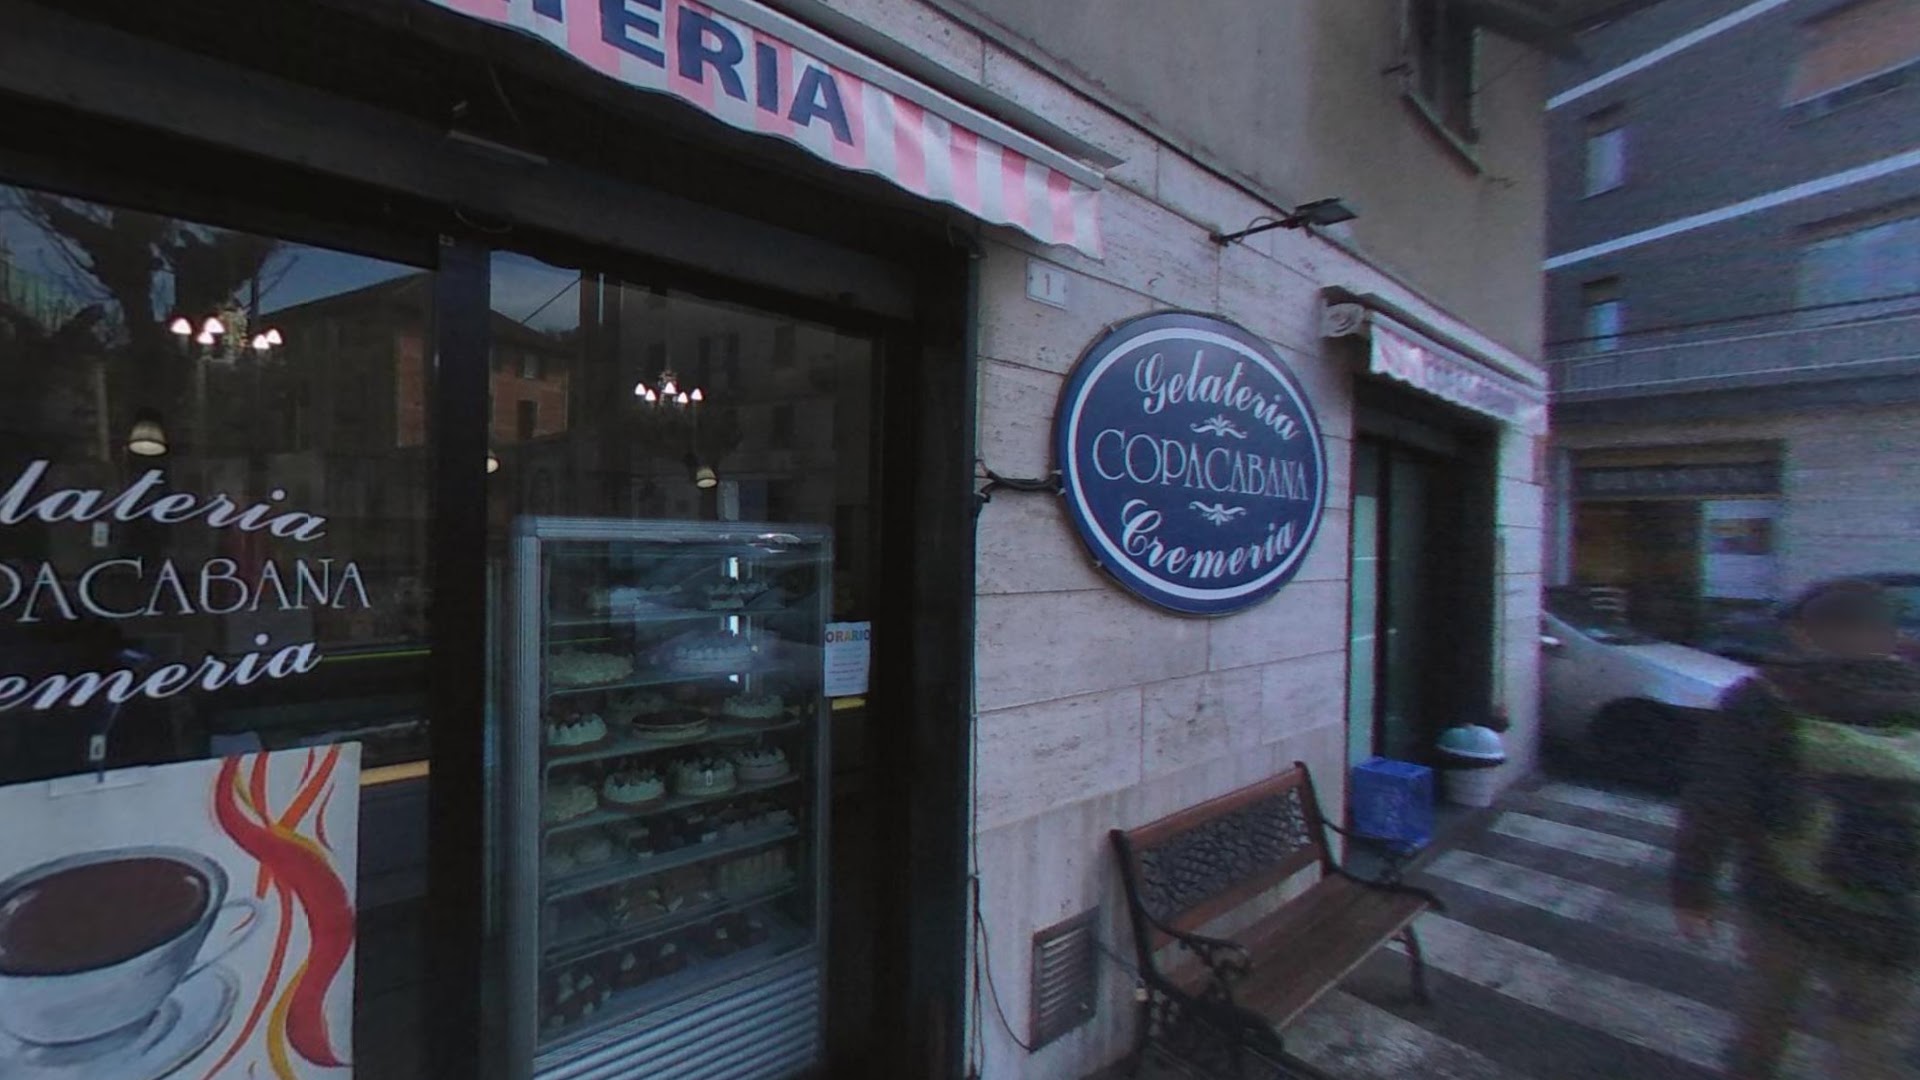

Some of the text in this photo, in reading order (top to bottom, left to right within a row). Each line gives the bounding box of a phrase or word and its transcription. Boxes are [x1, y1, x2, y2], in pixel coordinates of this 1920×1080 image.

[1134, 350, 1298, 440] Gelateria
[1092, 428, 1309, 501] COPACABANA
[1121, 498, 1297, 578] Cremeria
[825, 628, 871, 643] ORARIO
